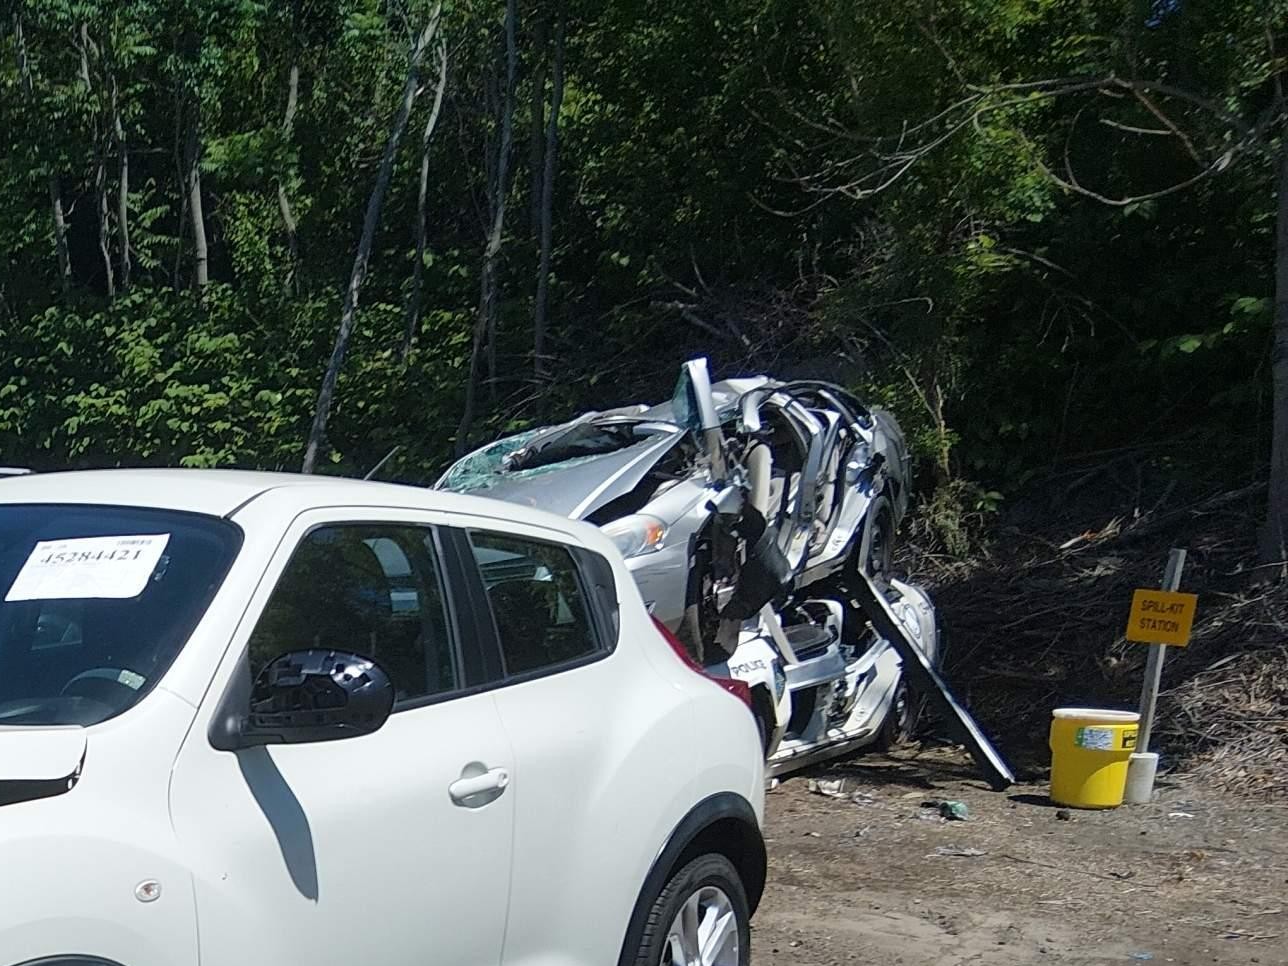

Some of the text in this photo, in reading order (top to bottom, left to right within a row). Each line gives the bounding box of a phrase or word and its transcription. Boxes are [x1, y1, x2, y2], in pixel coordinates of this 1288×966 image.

[40, 549, 143, 565] 45284421
[1140, 599, 1185, 614] SPILL-KIT
[1139, 617, 1180, 632] STATION
[730, 659, 767, 677] POLICE
